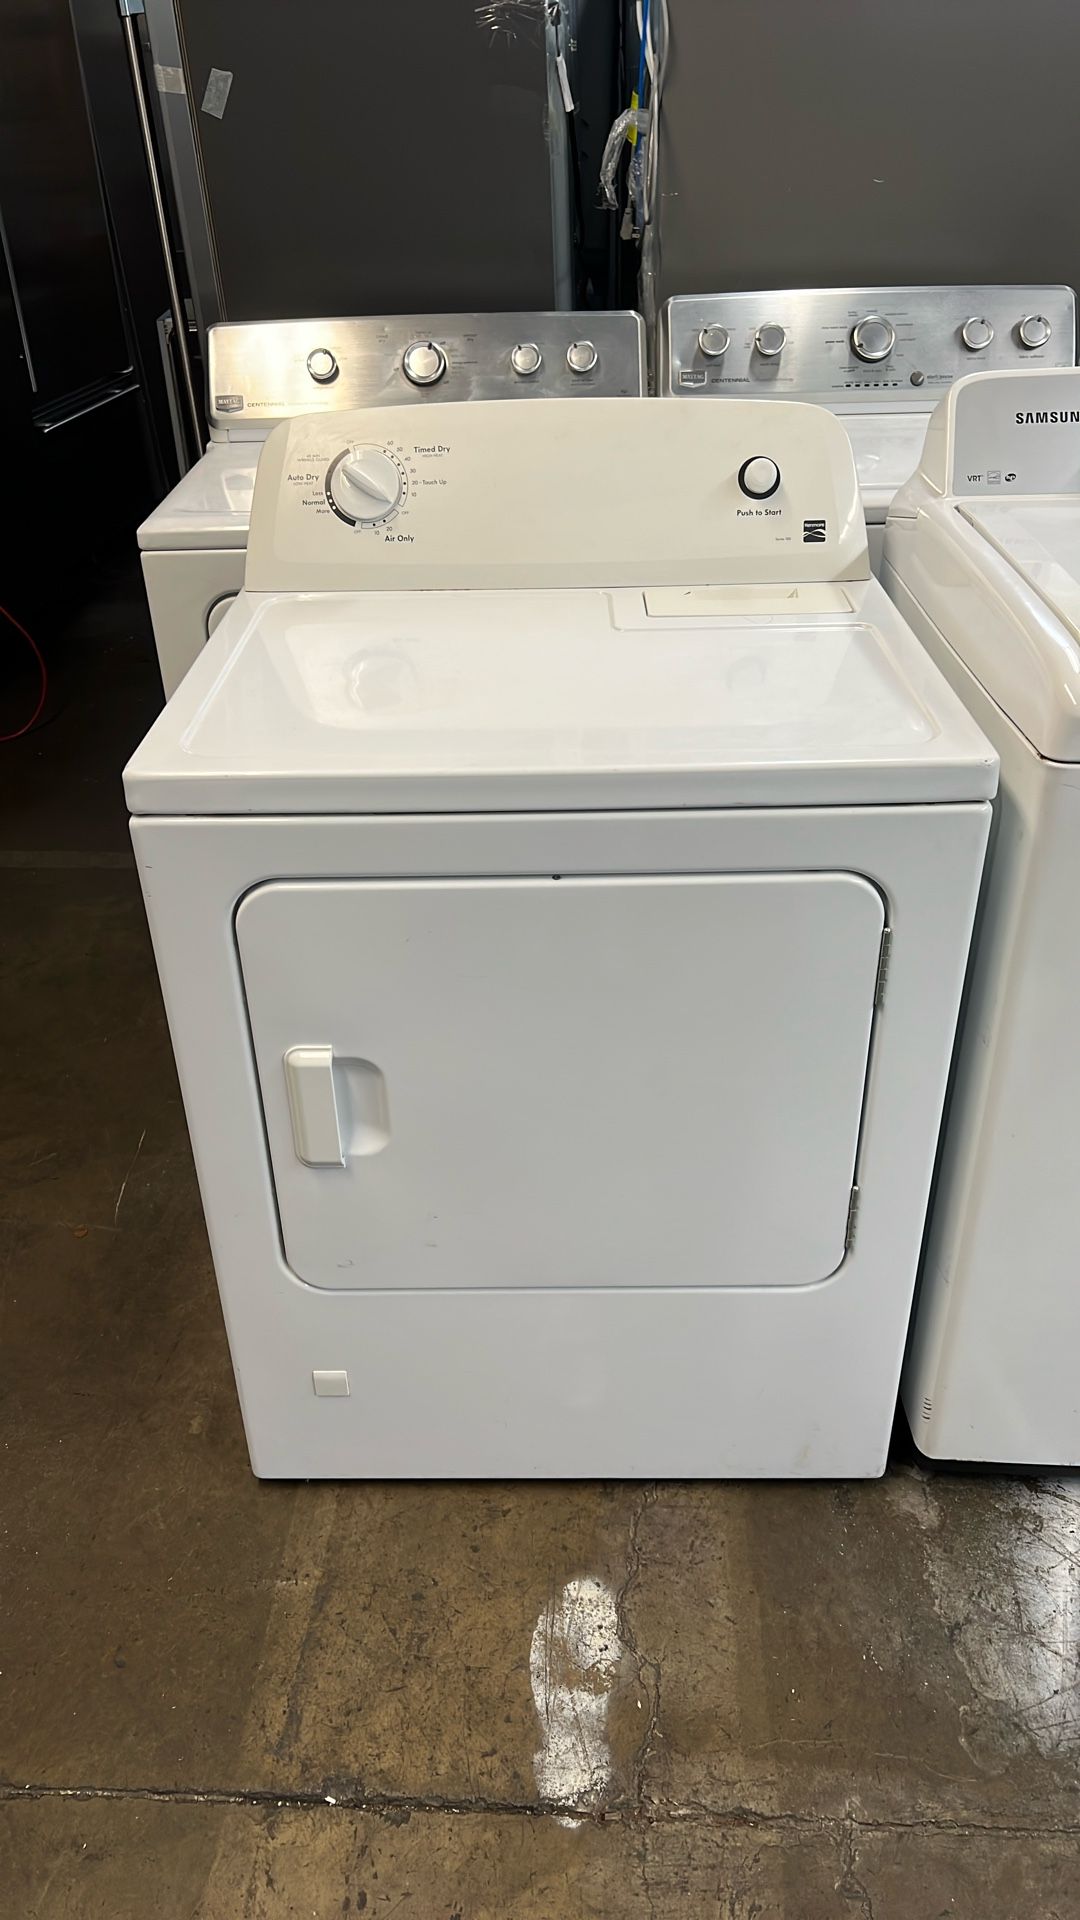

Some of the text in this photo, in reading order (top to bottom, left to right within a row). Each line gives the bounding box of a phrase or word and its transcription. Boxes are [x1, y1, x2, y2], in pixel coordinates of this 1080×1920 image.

[437, 445, 451, 454] Dry
[306, 474, 319, 482] Dry
[397, 535, 415, 543] Only
